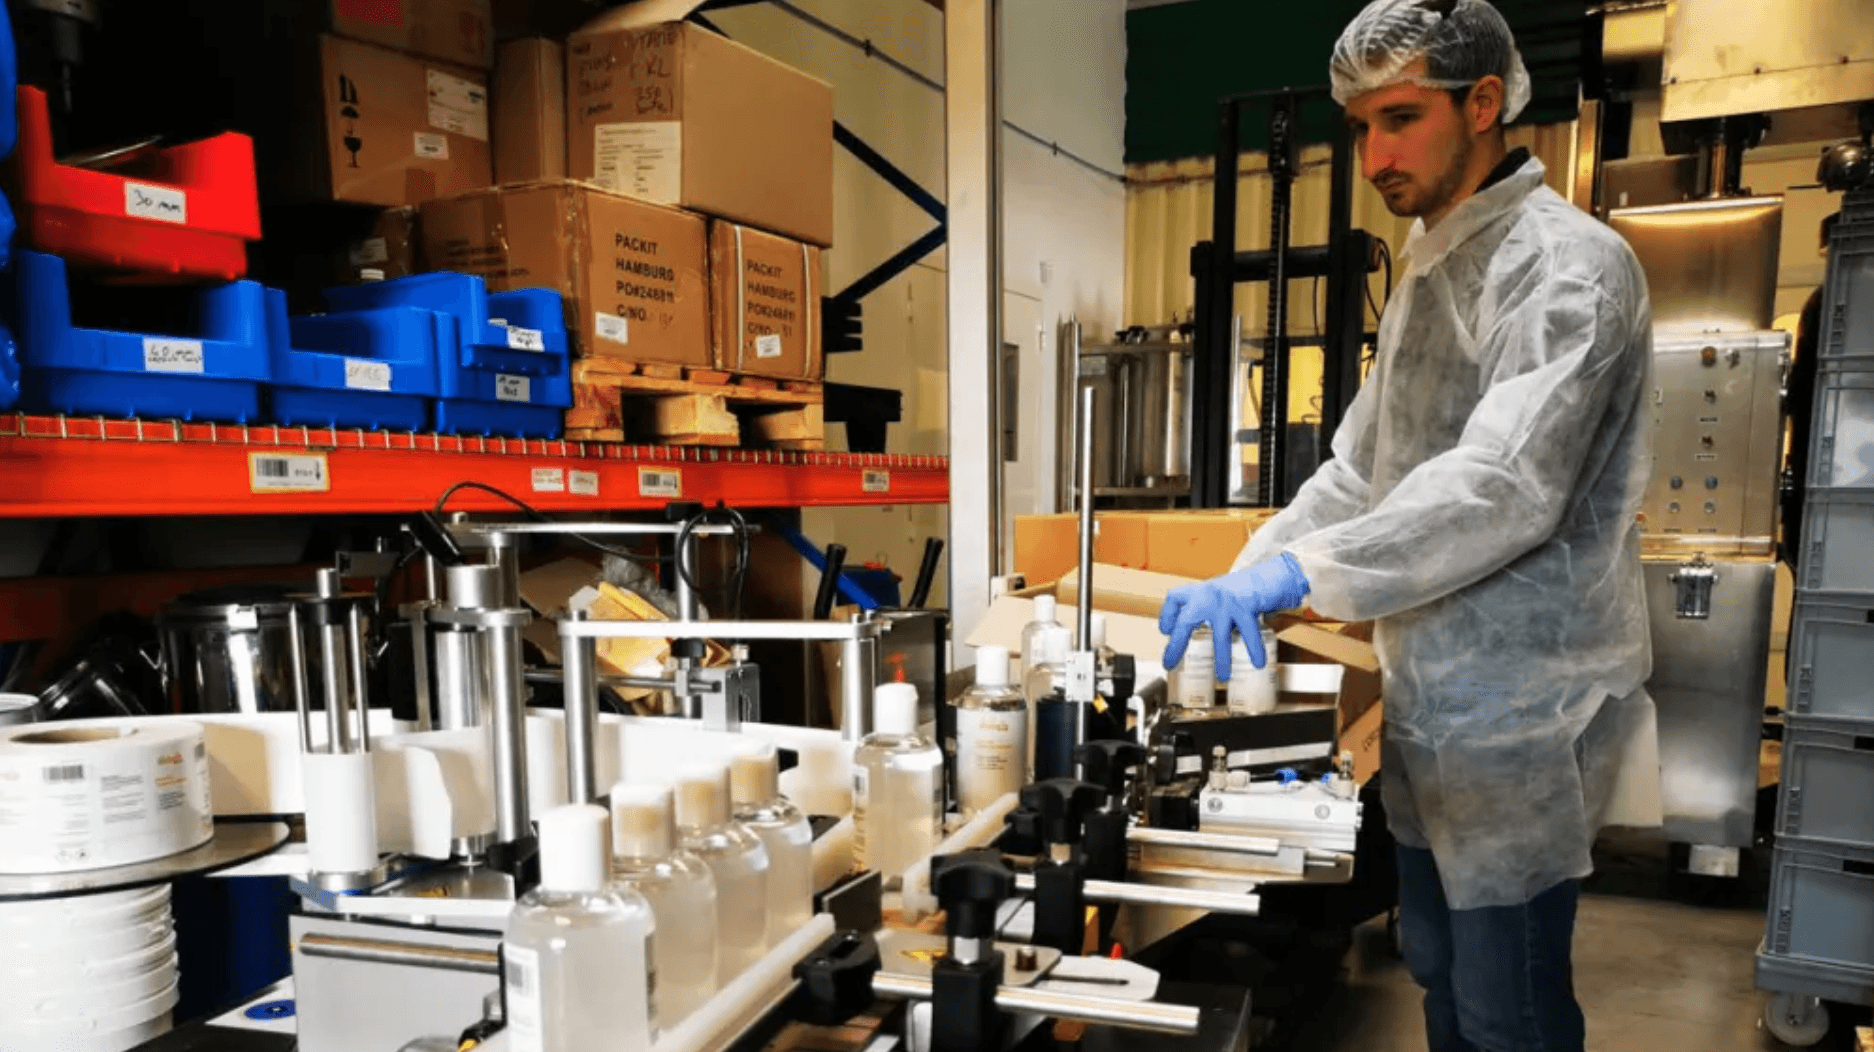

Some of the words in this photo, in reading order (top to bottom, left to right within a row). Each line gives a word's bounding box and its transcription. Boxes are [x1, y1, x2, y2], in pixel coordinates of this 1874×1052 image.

[615, 232, 658, 256] PACKIT
[615, 257, 675, 283] HAMBURG
[746, 259, 782, 279] PACKIT
[747, 280, 796, 304] HAMBURG
